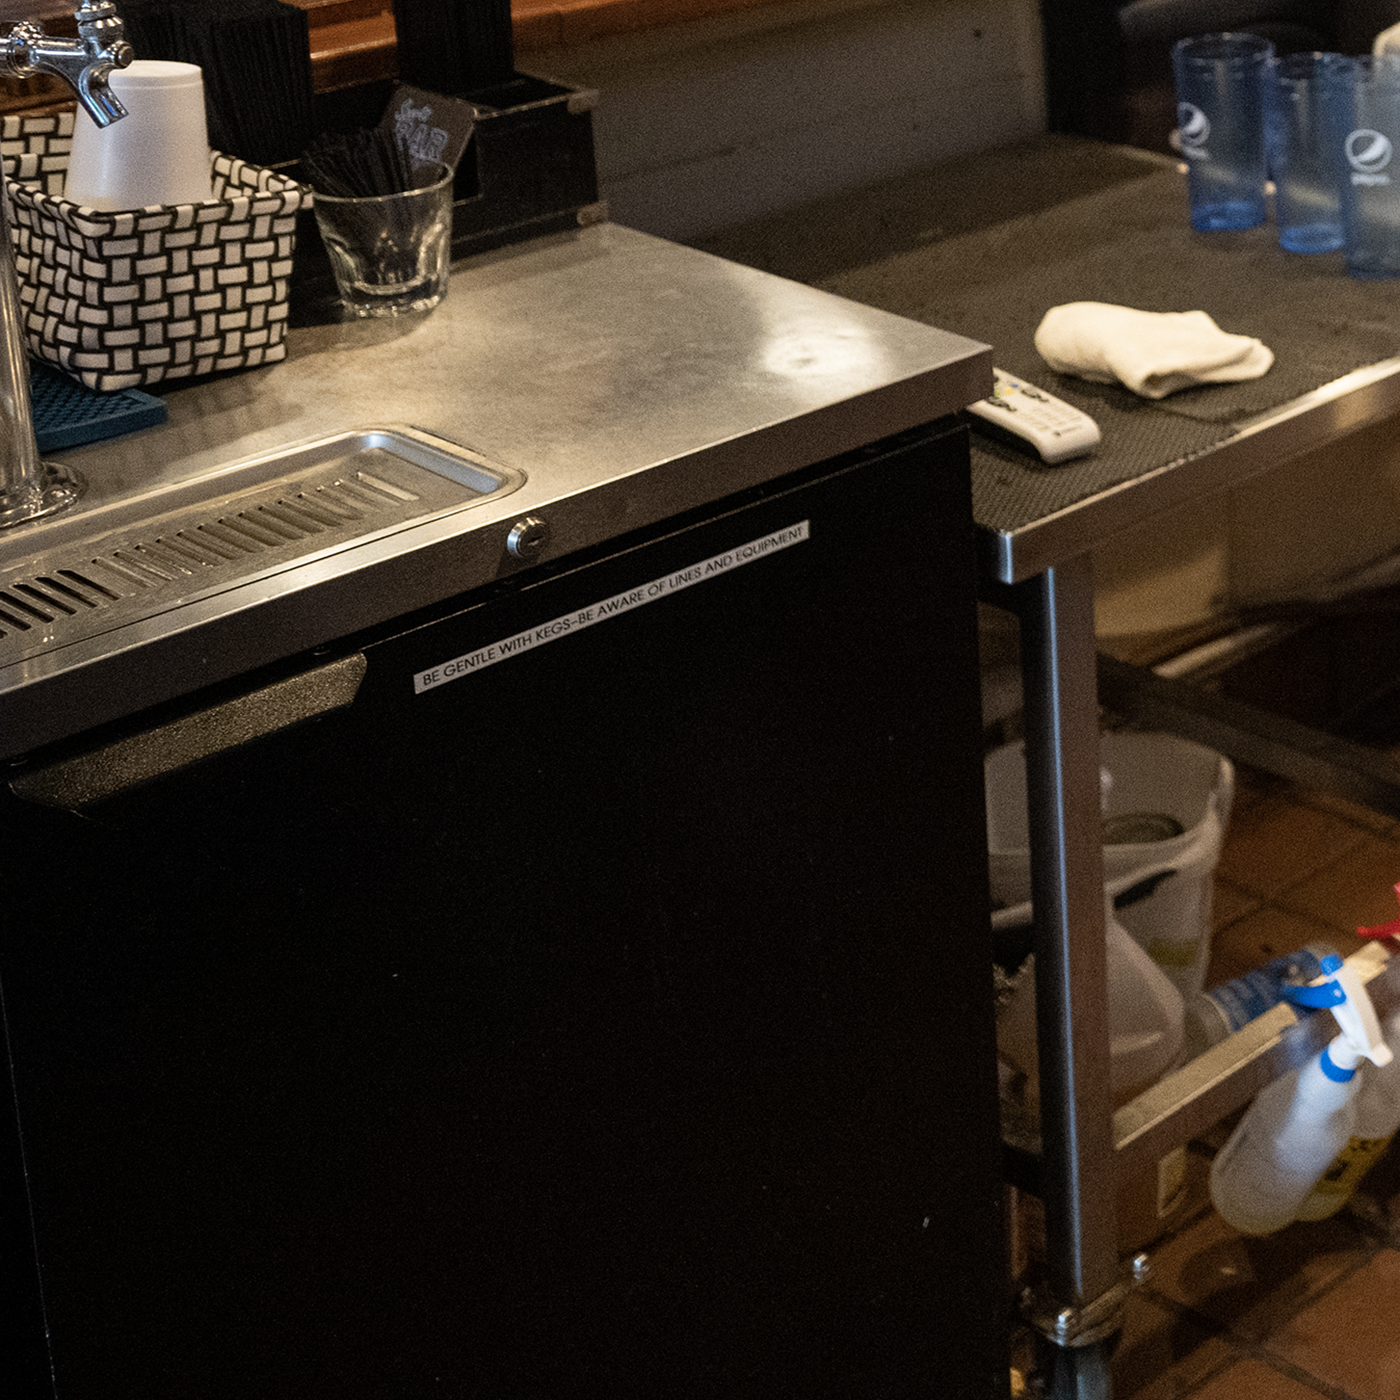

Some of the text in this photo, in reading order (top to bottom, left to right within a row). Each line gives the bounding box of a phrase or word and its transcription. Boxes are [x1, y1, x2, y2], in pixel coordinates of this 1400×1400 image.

[423, 669, 442, 686] BE
[444, 647, 496, 677] GENTLE
[499, 633, 533, 657] WITH
[598, 590, 645, 618] AWARE
[648, 580, 667, 600] OF
[669, 566, 702, 591] LINES
[705, 555, 733, 577] AND
[736, 526, 804, 564] EQUIPMENT
